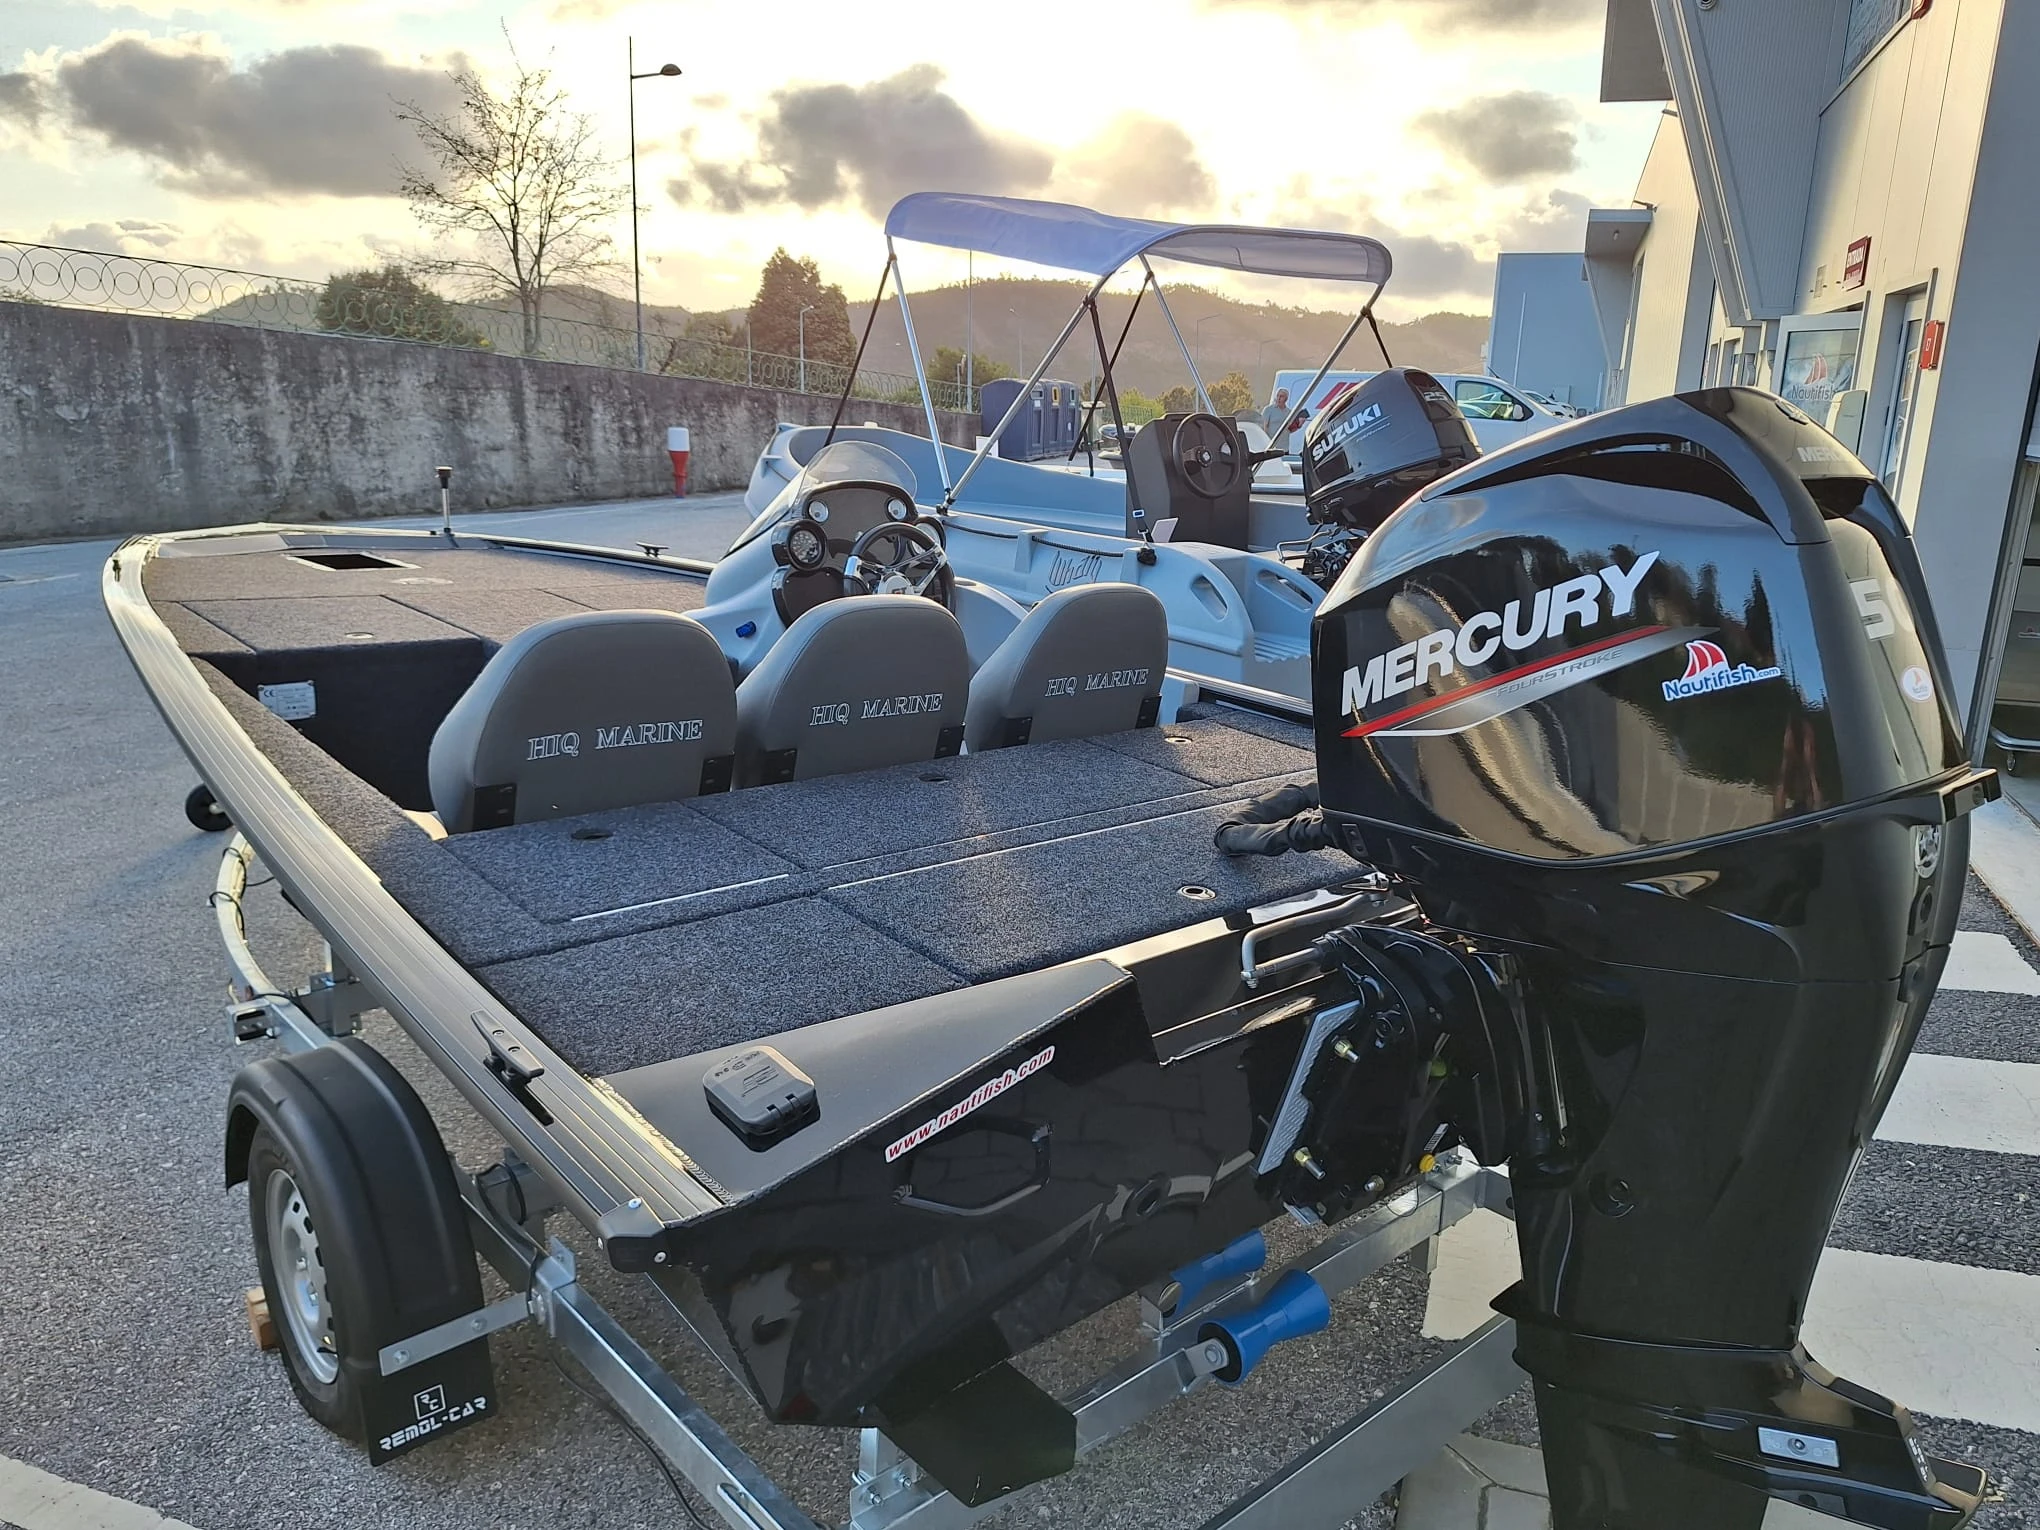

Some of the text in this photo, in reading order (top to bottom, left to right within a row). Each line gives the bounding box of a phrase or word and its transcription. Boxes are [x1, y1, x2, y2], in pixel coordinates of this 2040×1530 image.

[1424, 391, 1449, 402] 25
[1313, 403, 1381, 461] SUZUKI
[1341, 551, 1660, 716] MERCURY
[1045, 669, 1149, 697] HIQ MARINE
[1496, 649, 1623, 697] FOURSTROKE
[1663, 666, 1779, 699] Nautifish.com
[810, 693, 943, 726] HIQ MARINE
[527, 719, 703, 760] HIQ MARINE
[887, 1049, 1053, 1158] www.nautifish.com
[380, 1396, 487, 1450] REMOL-CAR
